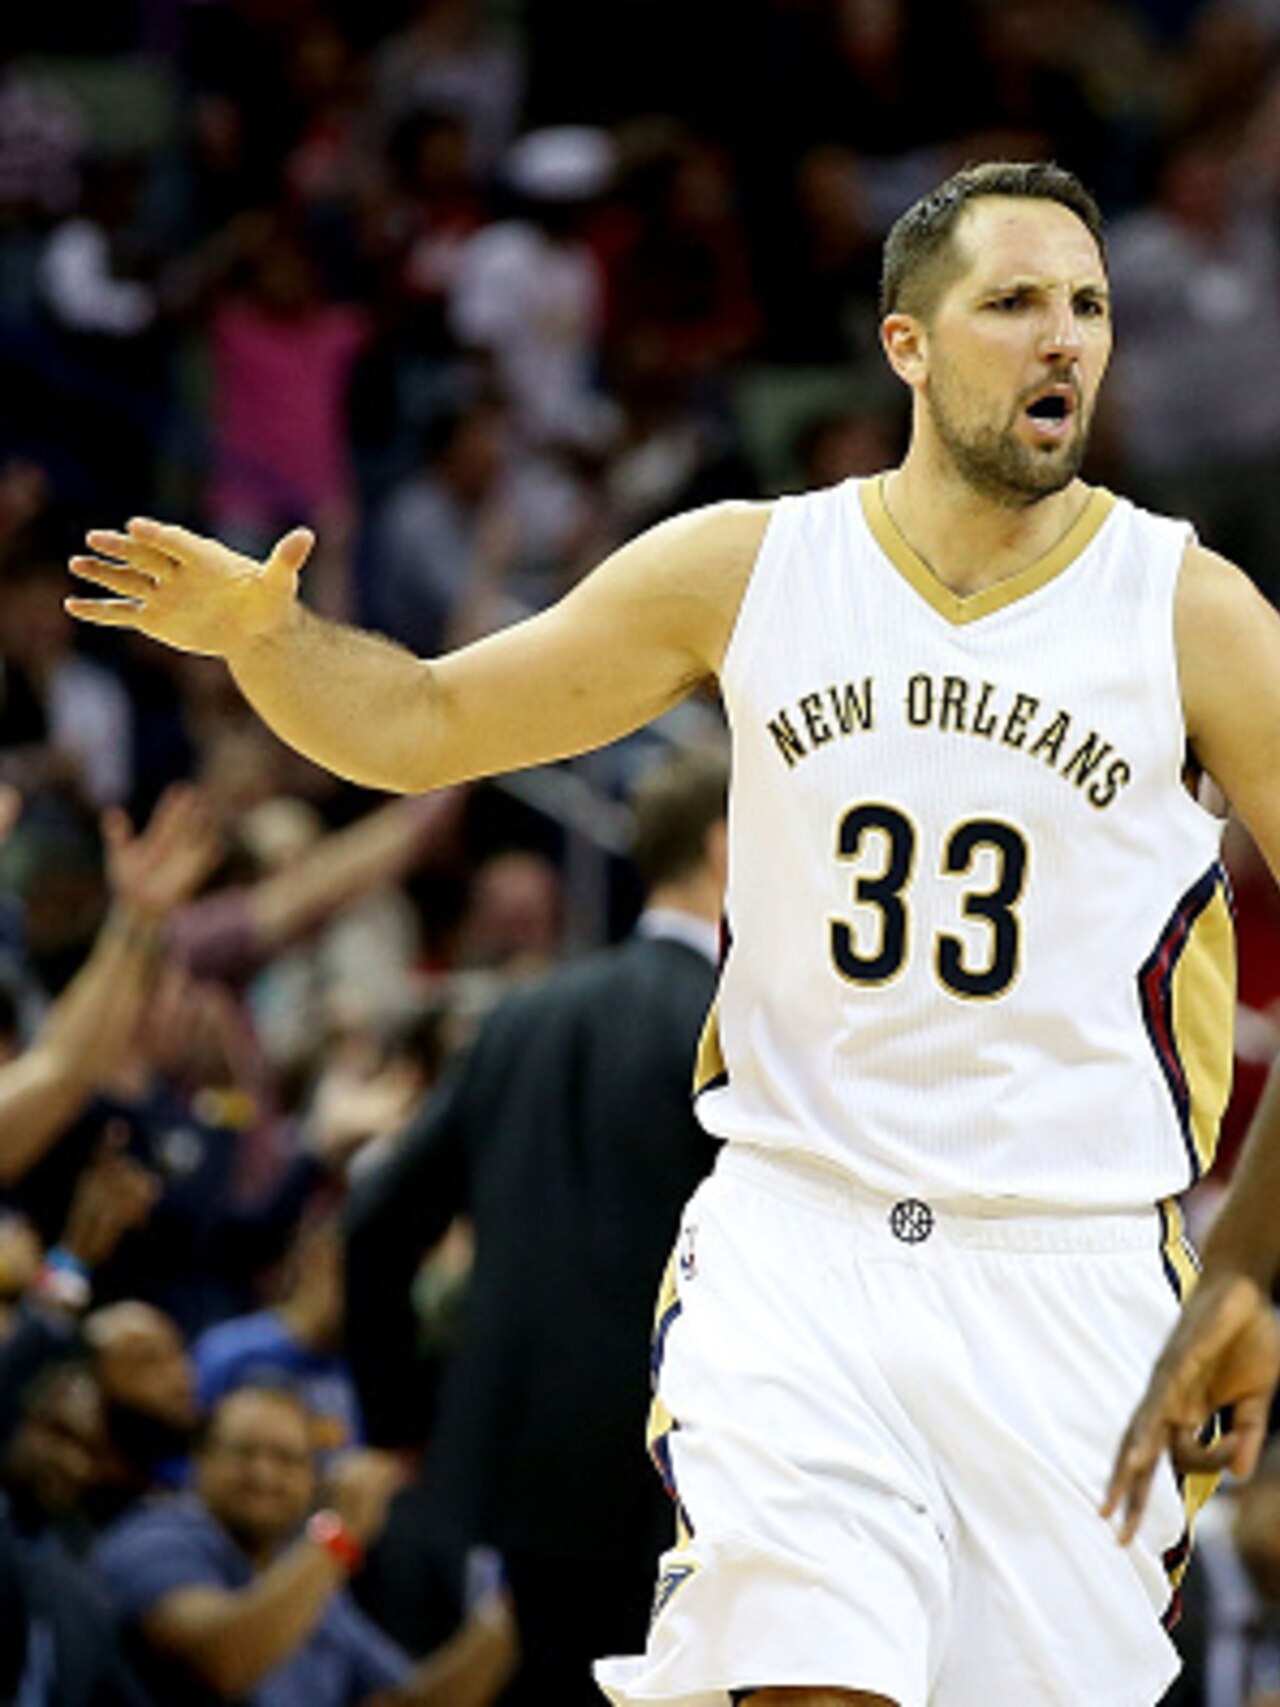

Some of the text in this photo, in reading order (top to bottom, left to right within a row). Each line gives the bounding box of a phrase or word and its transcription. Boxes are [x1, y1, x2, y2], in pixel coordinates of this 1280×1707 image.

[766, 672, 1132, 810] NEW ORLEANS
[828, 801, 1030, 1001] 33
